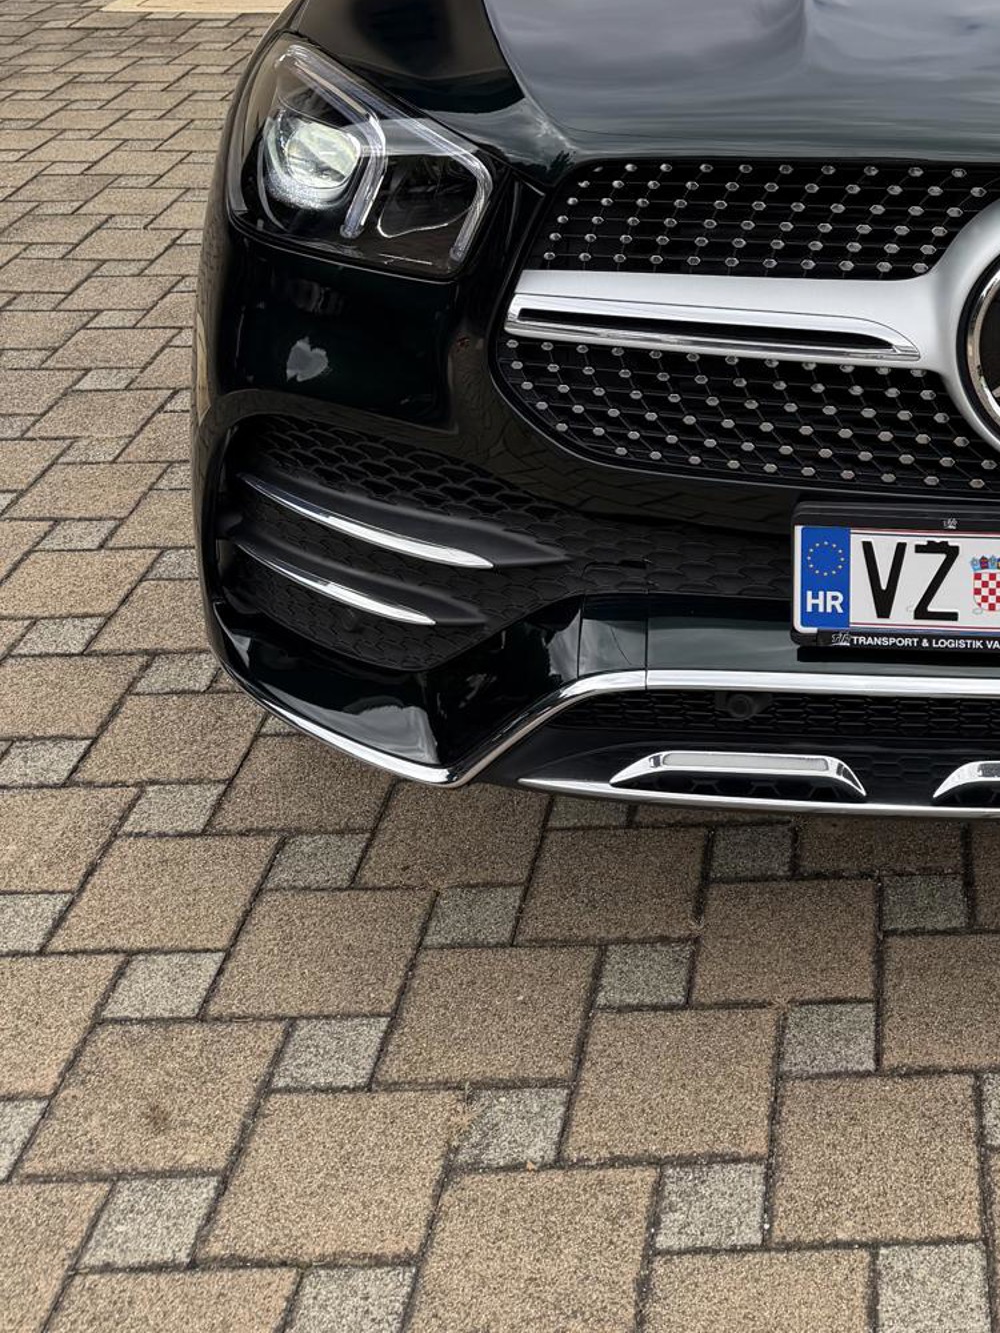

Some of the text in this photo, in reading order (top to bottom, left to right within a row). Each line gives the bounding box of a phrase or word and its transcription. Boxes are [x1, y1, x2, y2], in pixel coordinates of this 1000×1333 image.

[805, 590, 844, 614] HR
[851, 635, 919, 648] TRANSPORT
[921, 638, 930, 648] &
[932, 638, 984, 649] LOGISTIK
